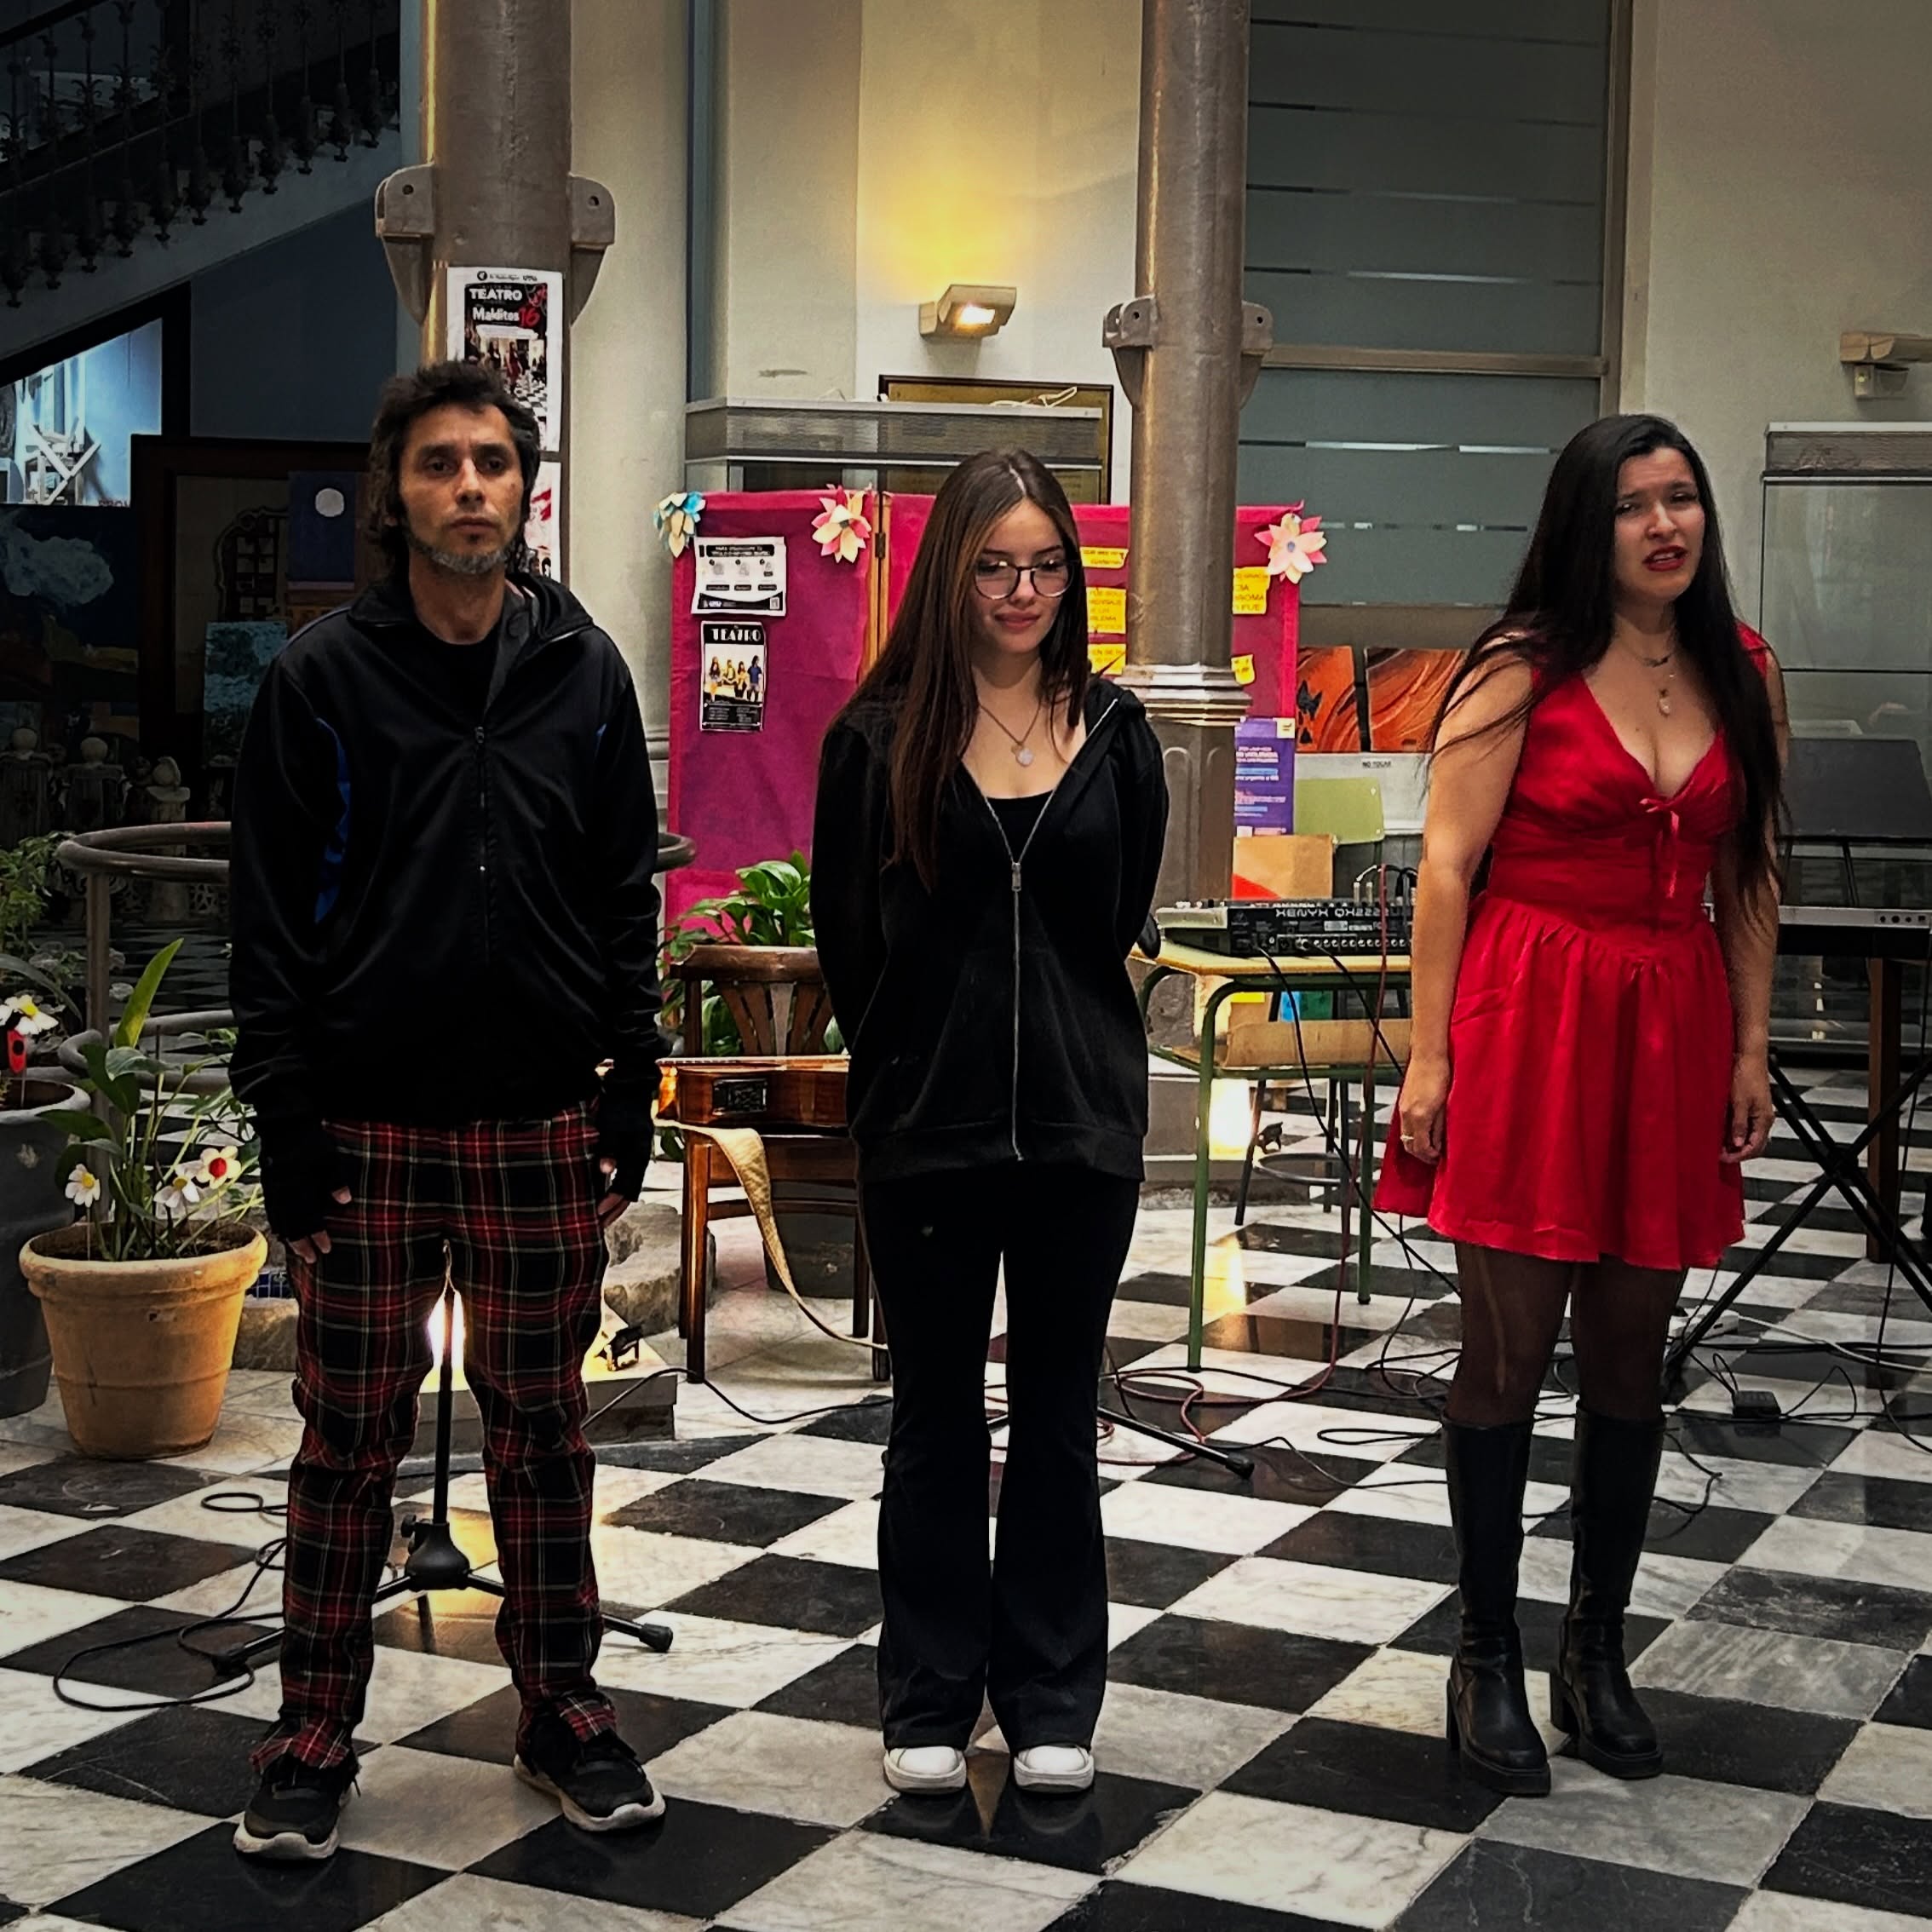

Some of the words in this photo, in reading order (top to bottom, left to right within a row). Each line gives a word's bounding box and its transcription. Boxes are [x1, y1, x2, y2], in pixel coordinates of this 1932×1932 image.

[469, 288, 523, 301] TEATRO
[472, 307, 520, 321] Malditos
[712, 628, 762, 641] TEATRO
[1275, 908, 1329, 917] XENYX
